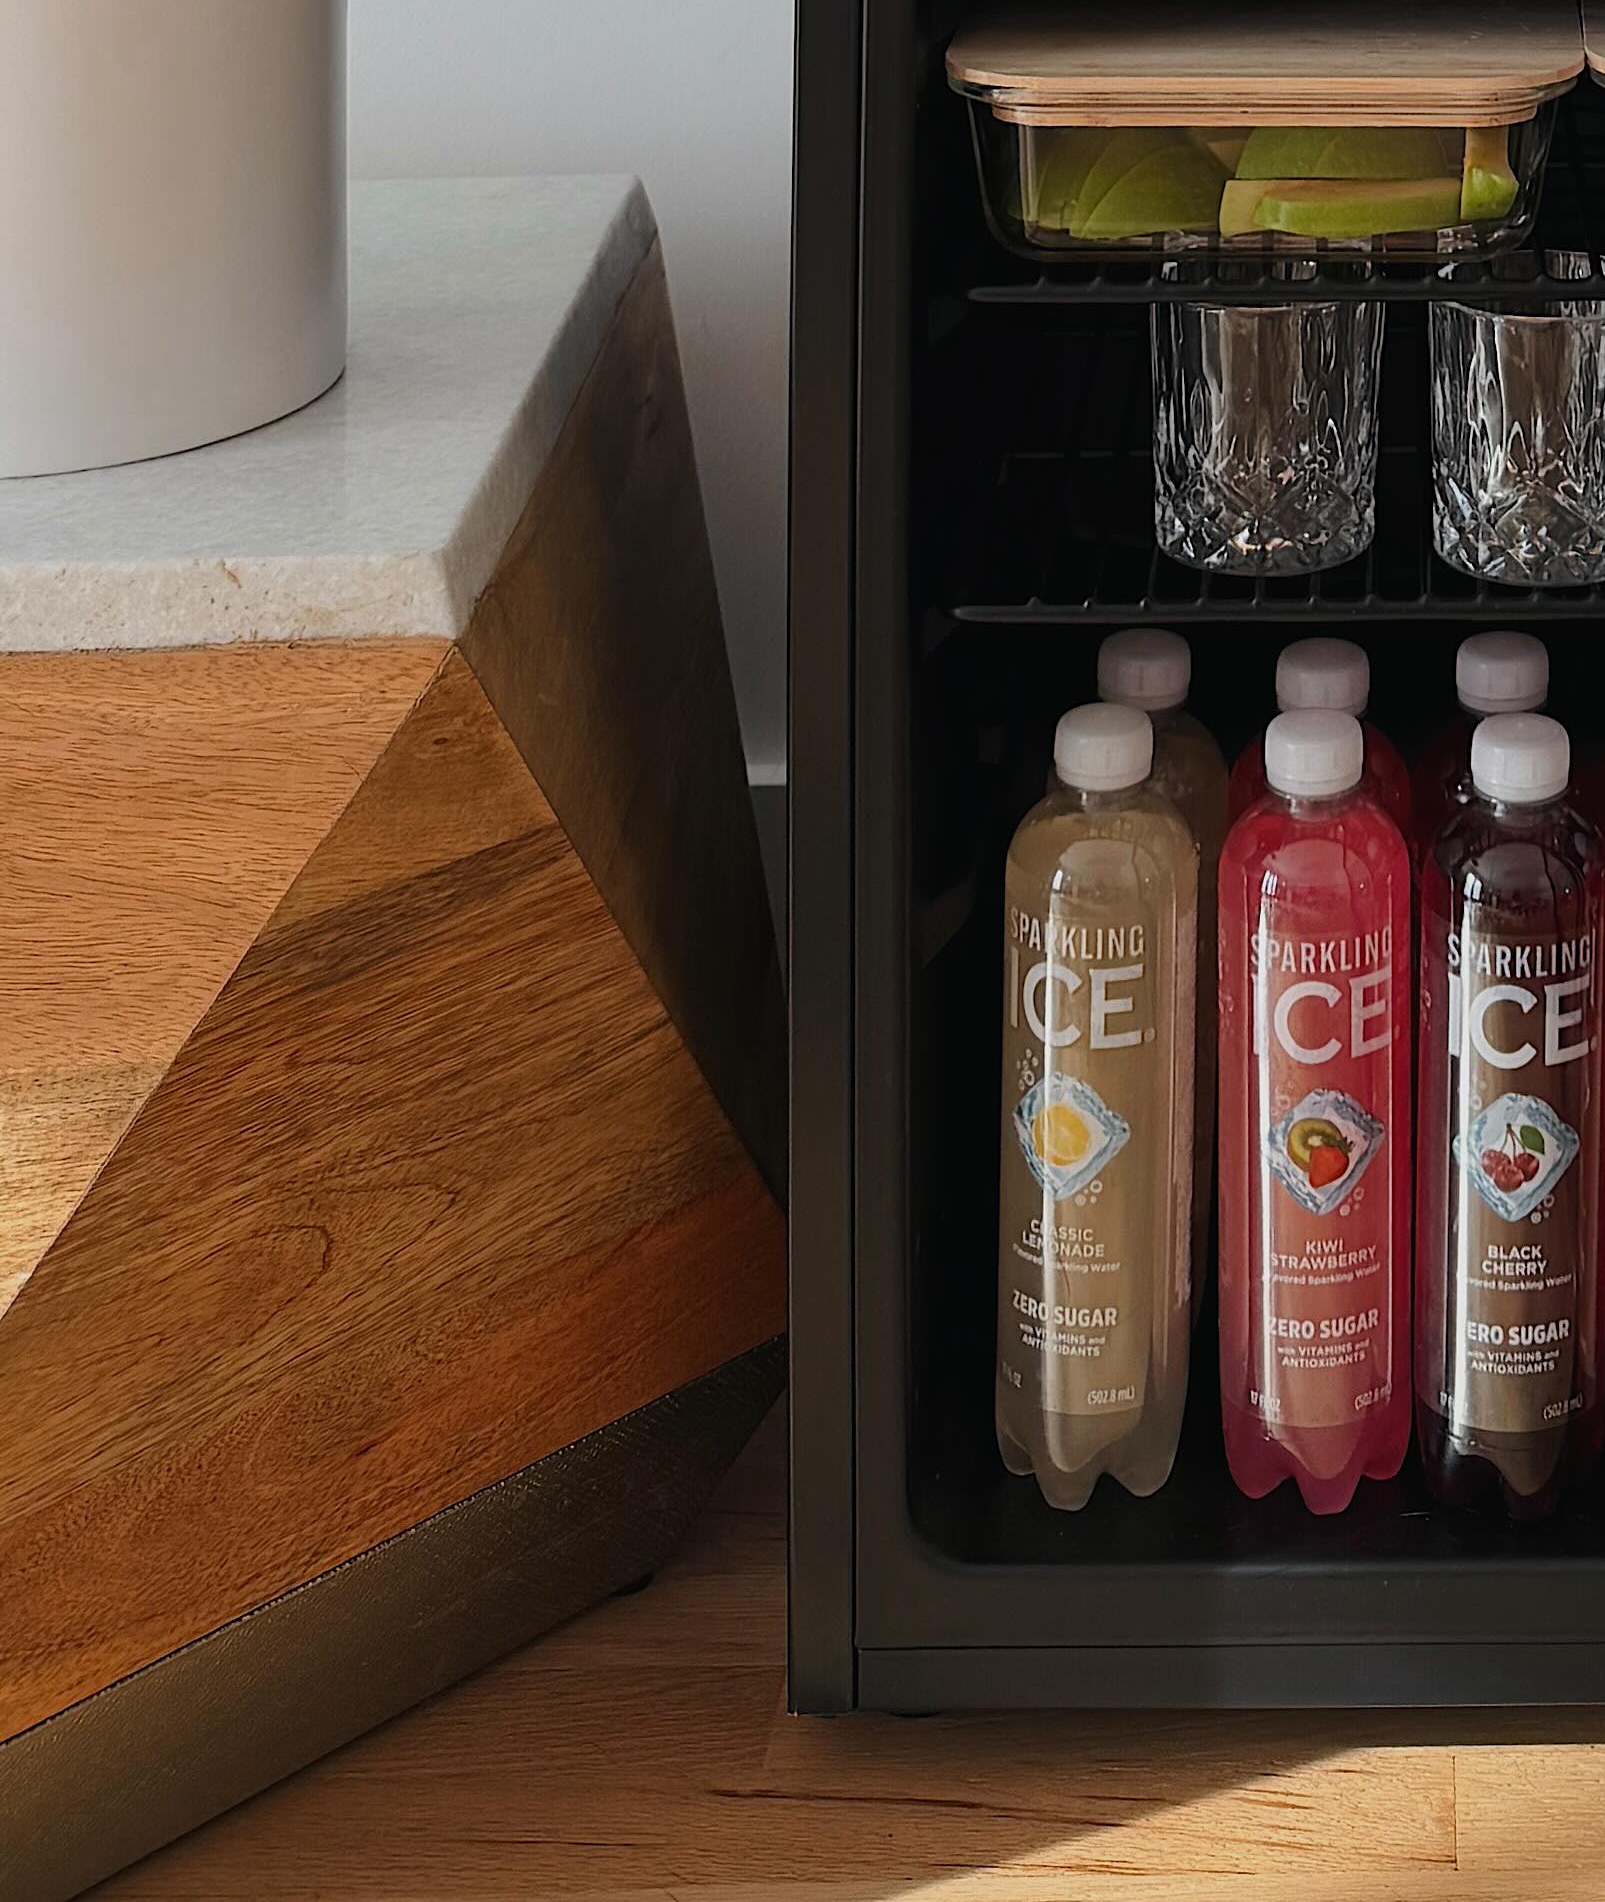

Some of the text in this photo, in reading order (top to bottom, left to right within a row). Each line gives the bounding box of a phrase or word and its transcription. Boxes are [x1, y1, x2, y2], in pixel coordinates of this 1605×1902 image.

[1011, 907, 1144, 960] SPARKLING
[1010, 947, 1144, 1050] ICE
[1448, 971, 1590, 1069] ICE
[1030, 1219, 1093, 1242] CASSIC
[1272, 1245, 1377, 1270] STRAWBERRY
[1306, 1238, 1343, 1254] KIWI
[1488, 1244, 1542, 1260] BLACK
[1482, 1260, 1547, 1275] CHERRY
[1013, 1289, 1117, 1327] ZERO SUGAR
[1269, 1308, 1379, 1339] ZERO SUGAR
[1466, 1319, 1569, 1345] ERO SUGAR
[1282, 1351, 1365, 1368] ANTIOXIDANTS
[1299, 1343, 1352, 1356] VITAMINS
[1488, 1351, 1541, 1362] VITAMINS
[1472, 1361, 1555, 1374] ANTIOXIDANTS
